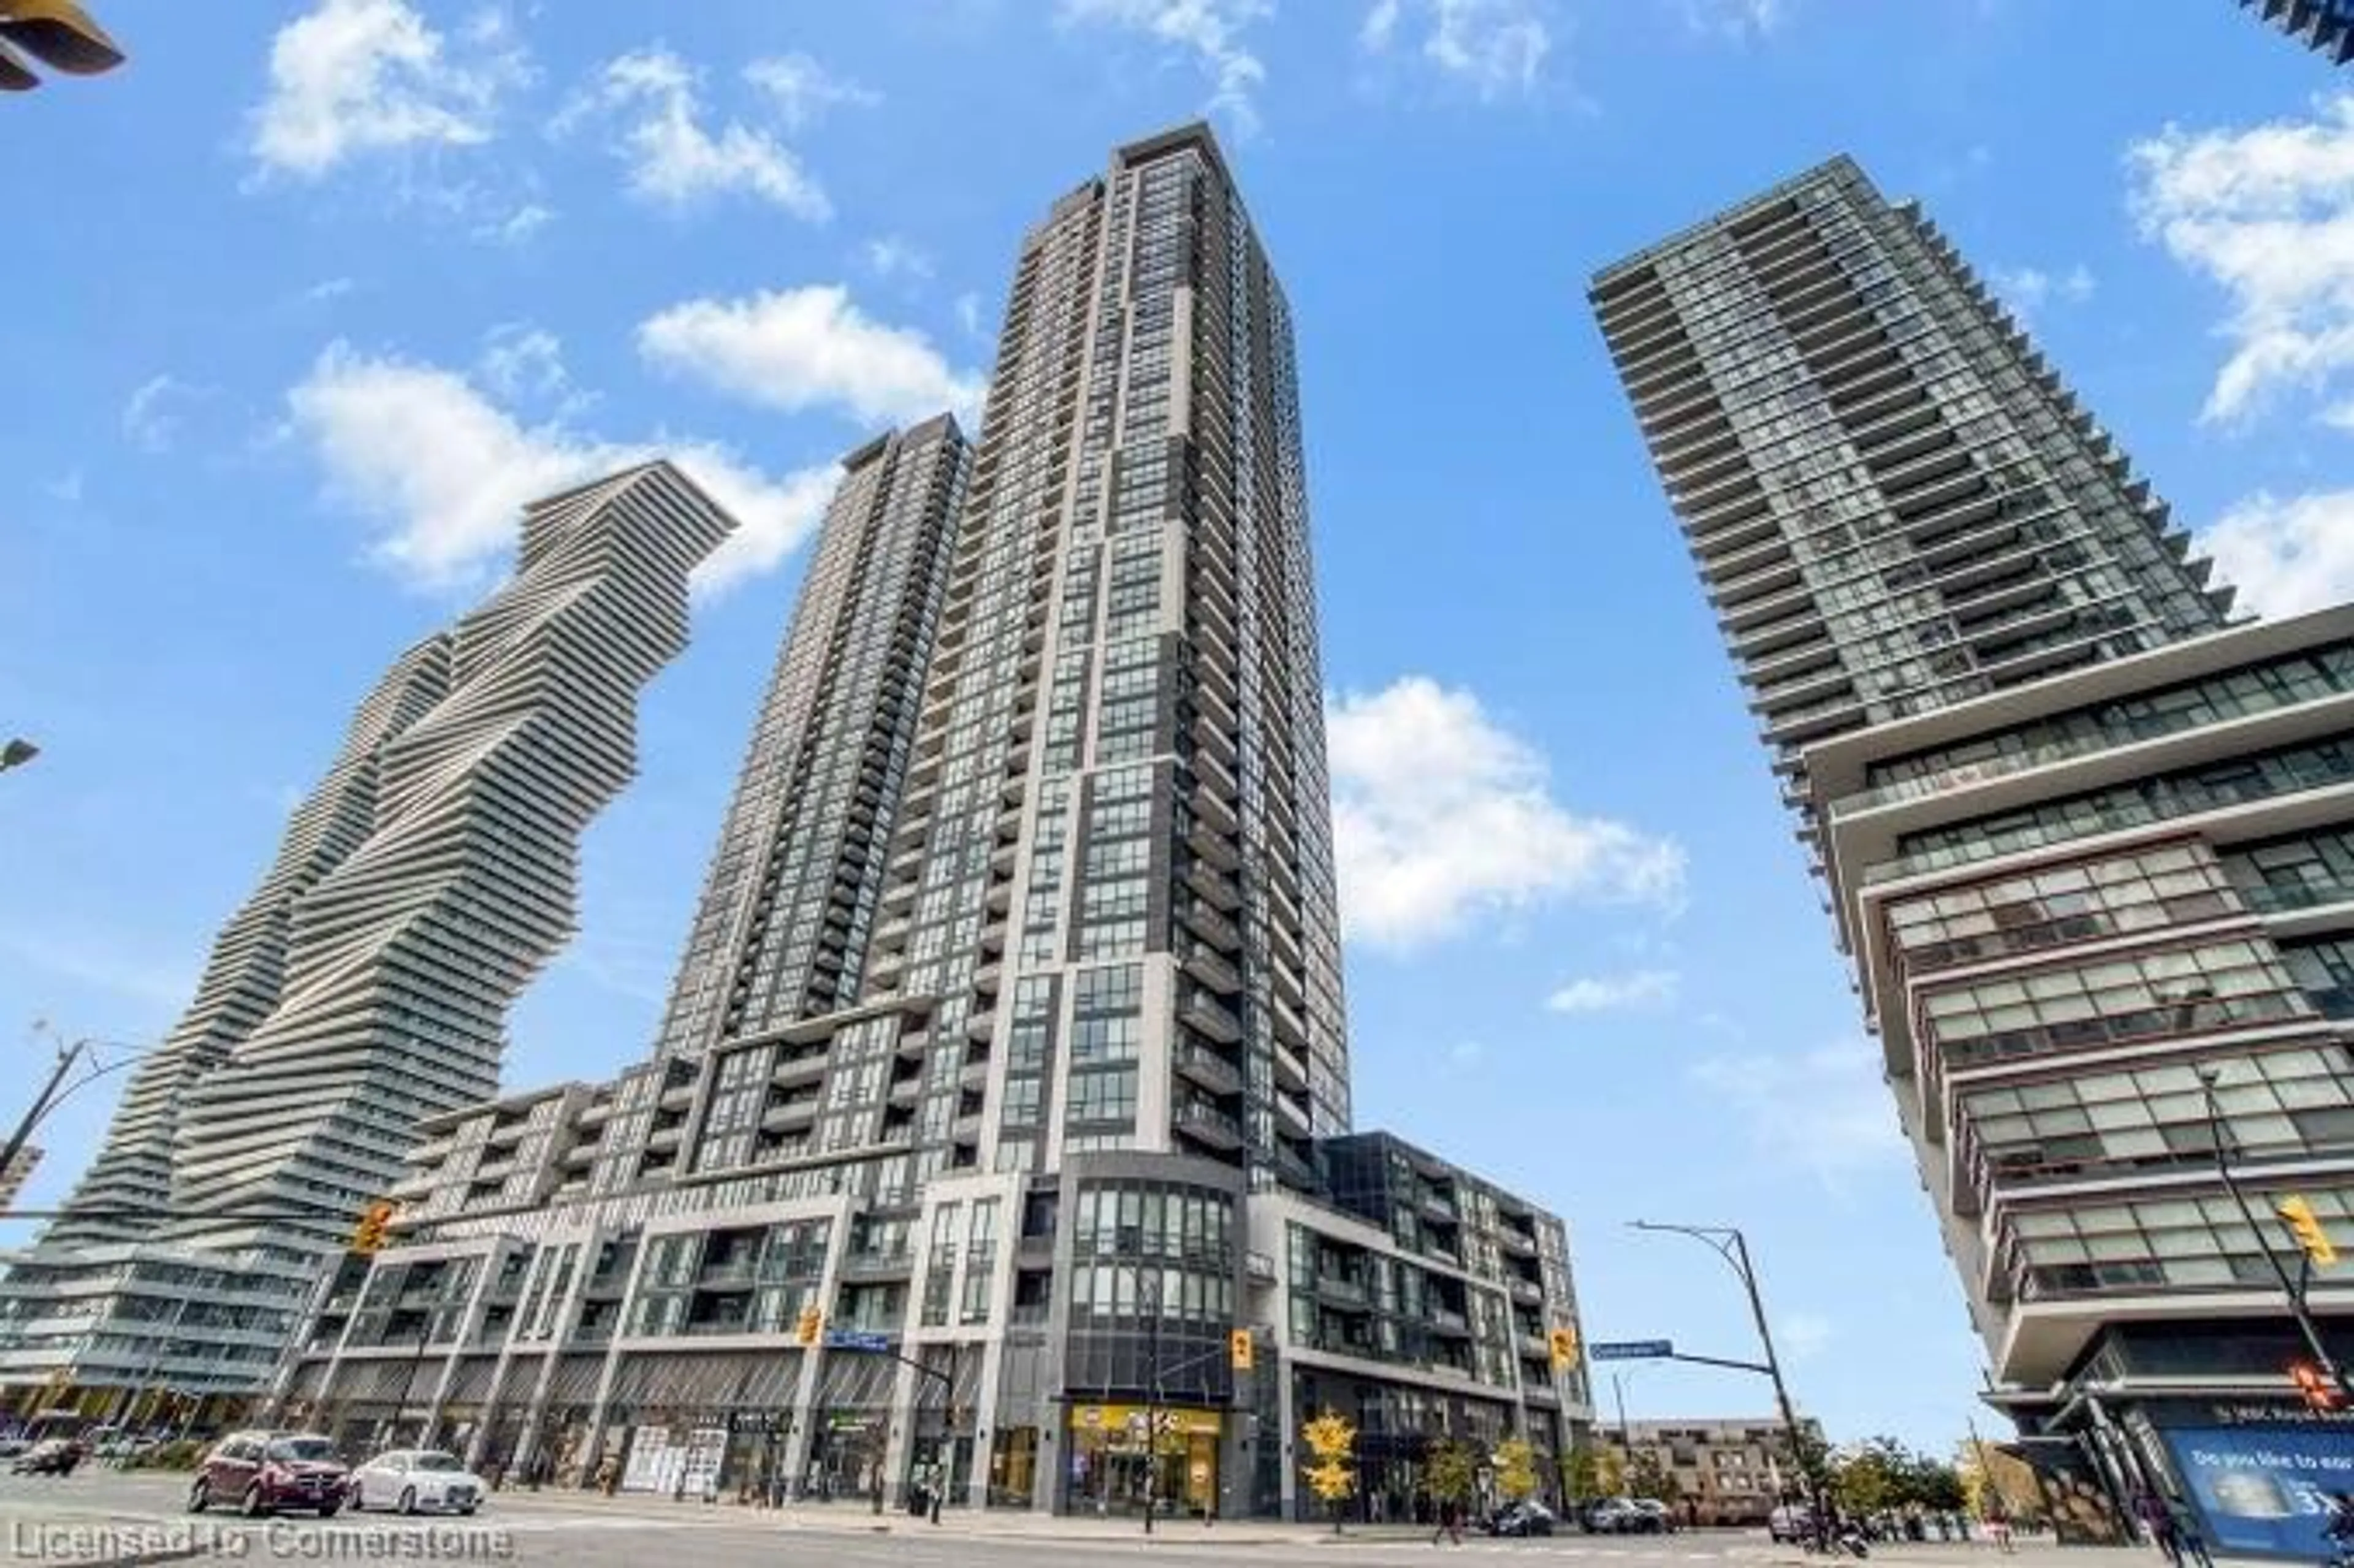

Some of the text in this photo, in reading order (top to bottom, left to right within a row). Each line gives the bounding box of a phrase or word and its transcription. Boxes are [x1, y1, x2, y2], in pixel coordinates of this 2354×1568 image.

[2222, 1453, 2255, 1469] you
[2256, 1450, 2294, 1469] like
[2294, 1453, 2317, 1469] to
